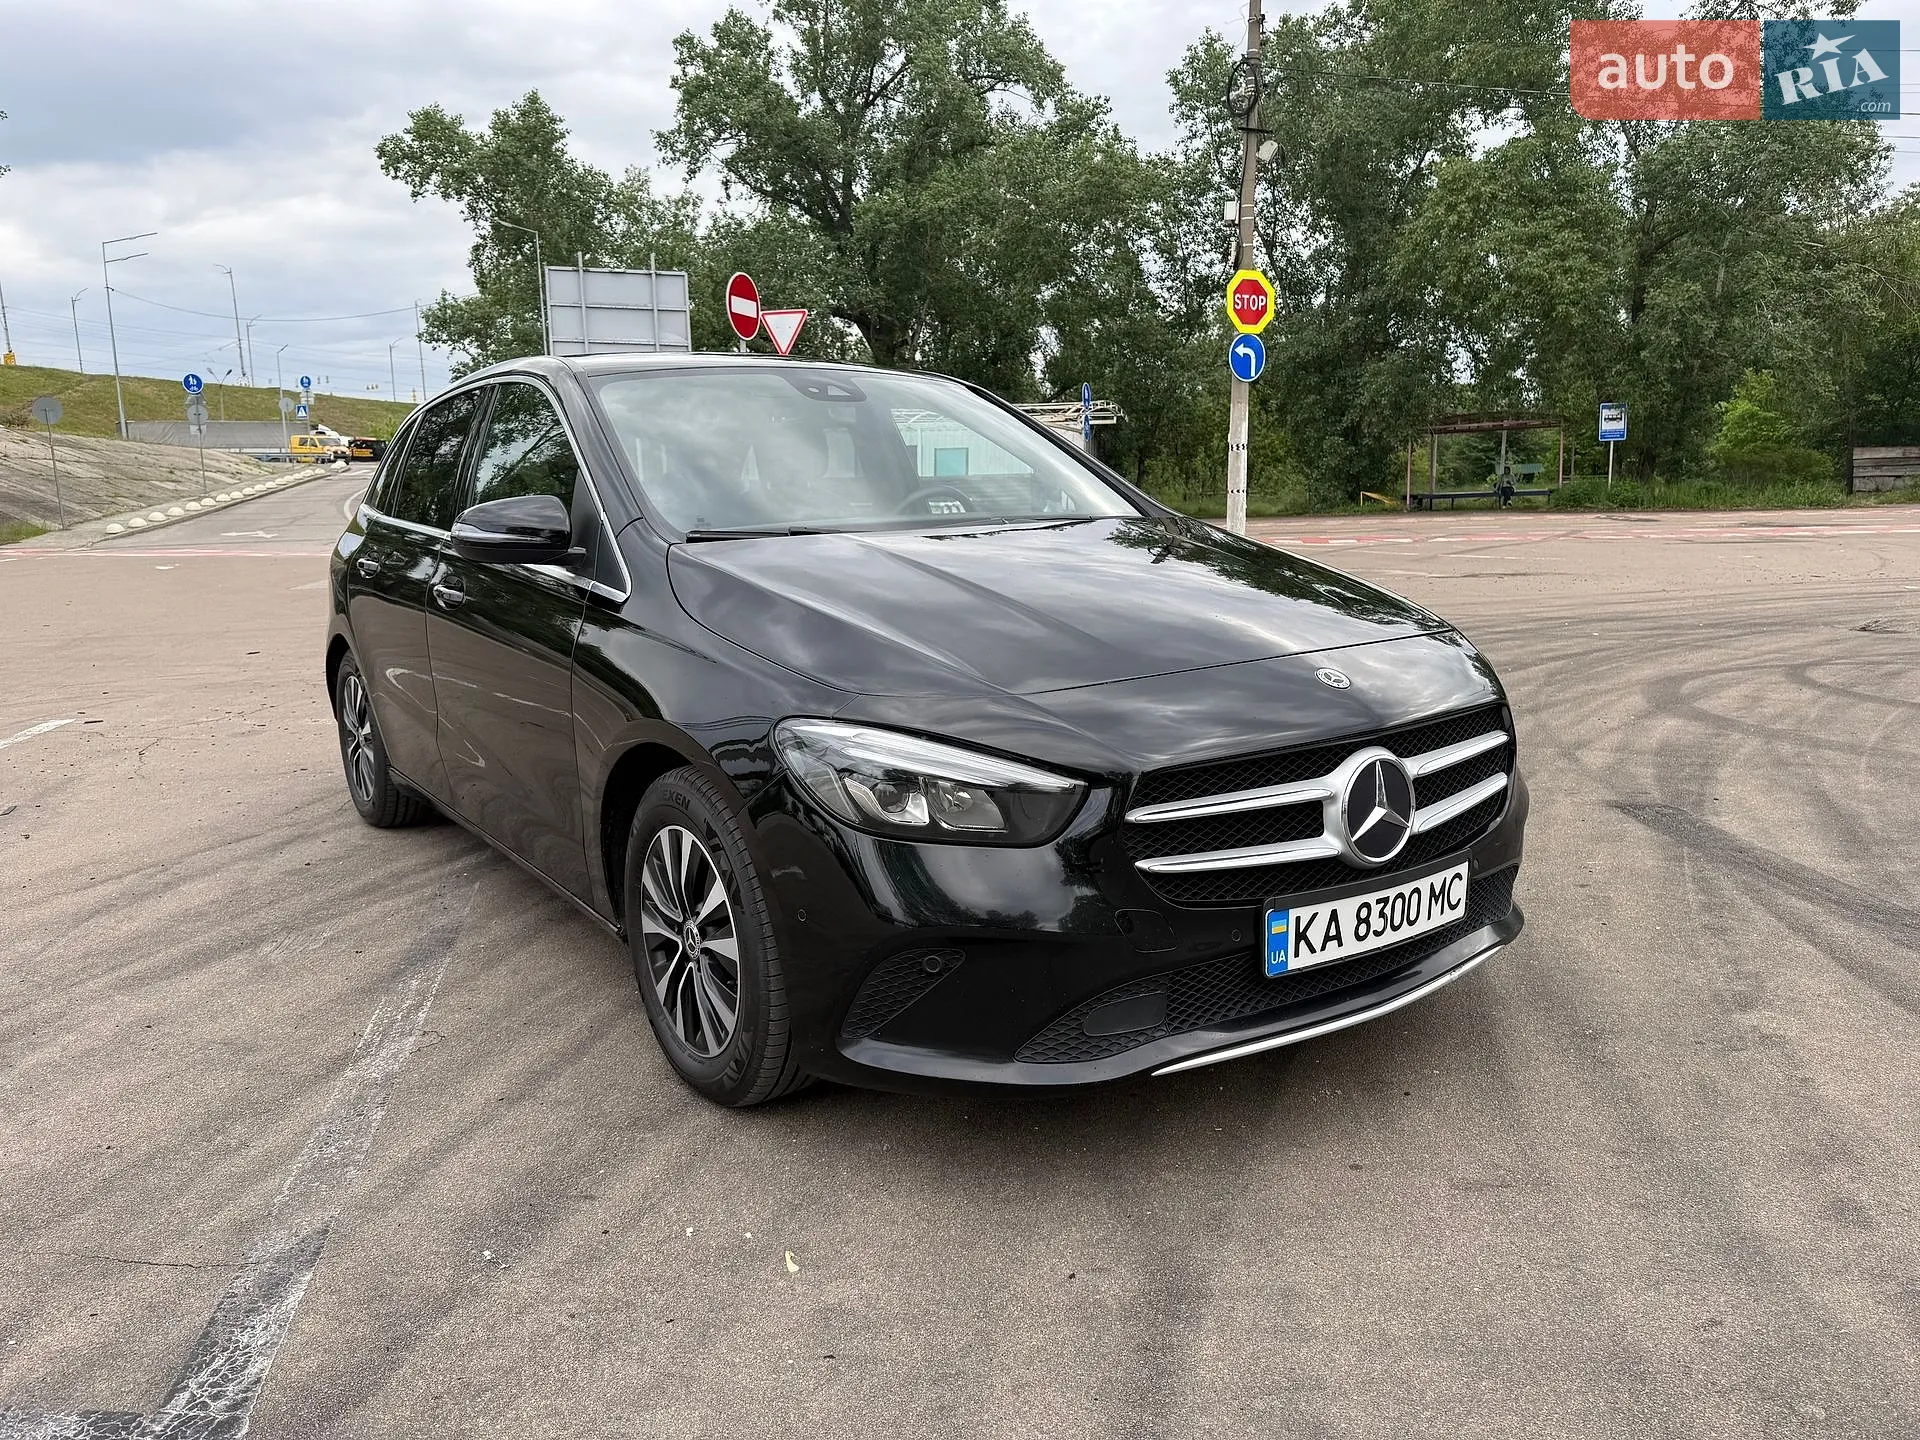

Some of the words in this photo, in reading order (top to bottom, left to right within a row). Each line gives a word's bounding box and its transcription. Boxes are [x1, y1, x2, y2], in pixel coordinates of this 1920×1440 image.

[1234, 293, 1266, 311] STOP
[661, 789, 691, 811] EXEN
[1293, 908, 1344, 959] KA
[1354, 886, 1422, 943] 8300
[1427, 872, 1463, 921] MC
[1272, 950, 1287, 965] UA
